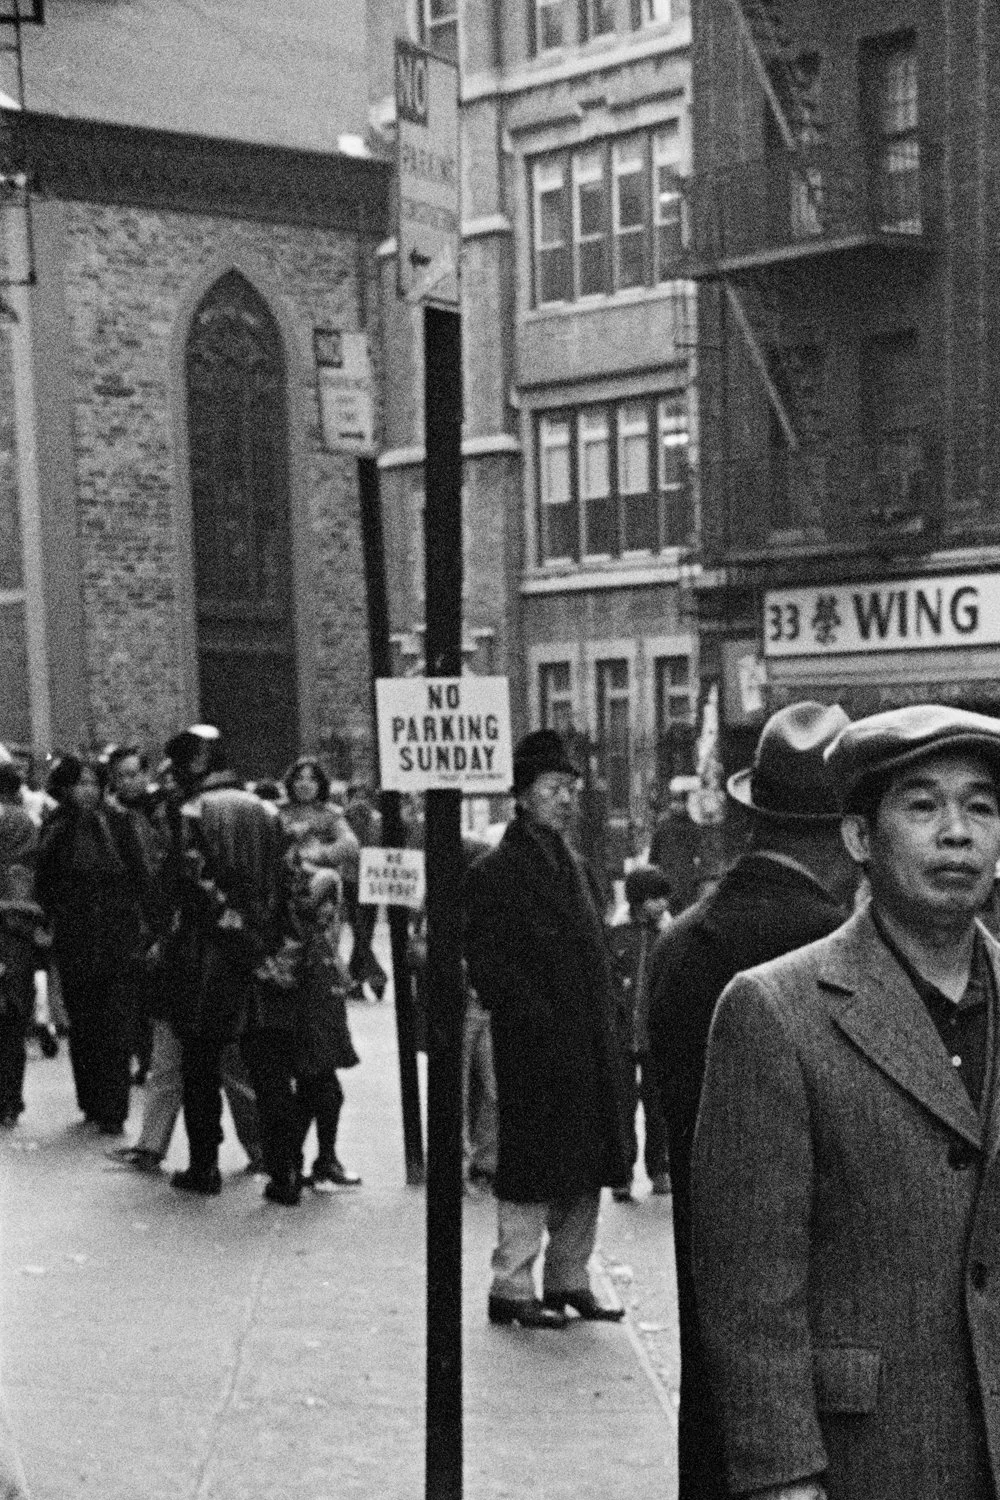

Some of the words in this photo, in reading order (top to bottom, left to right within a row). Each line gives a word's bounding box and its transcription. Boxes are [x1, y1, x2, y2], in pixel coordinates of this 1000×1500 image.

[397, 52, 427, 118] NO
[769, 603, 800, 642] 33
[852, 586, 979, 640] WING
[427, 684, 462, 710] NO
[391, 714, 500, 743] PARKING
[399, 745, 496, 772] SUNDAY
